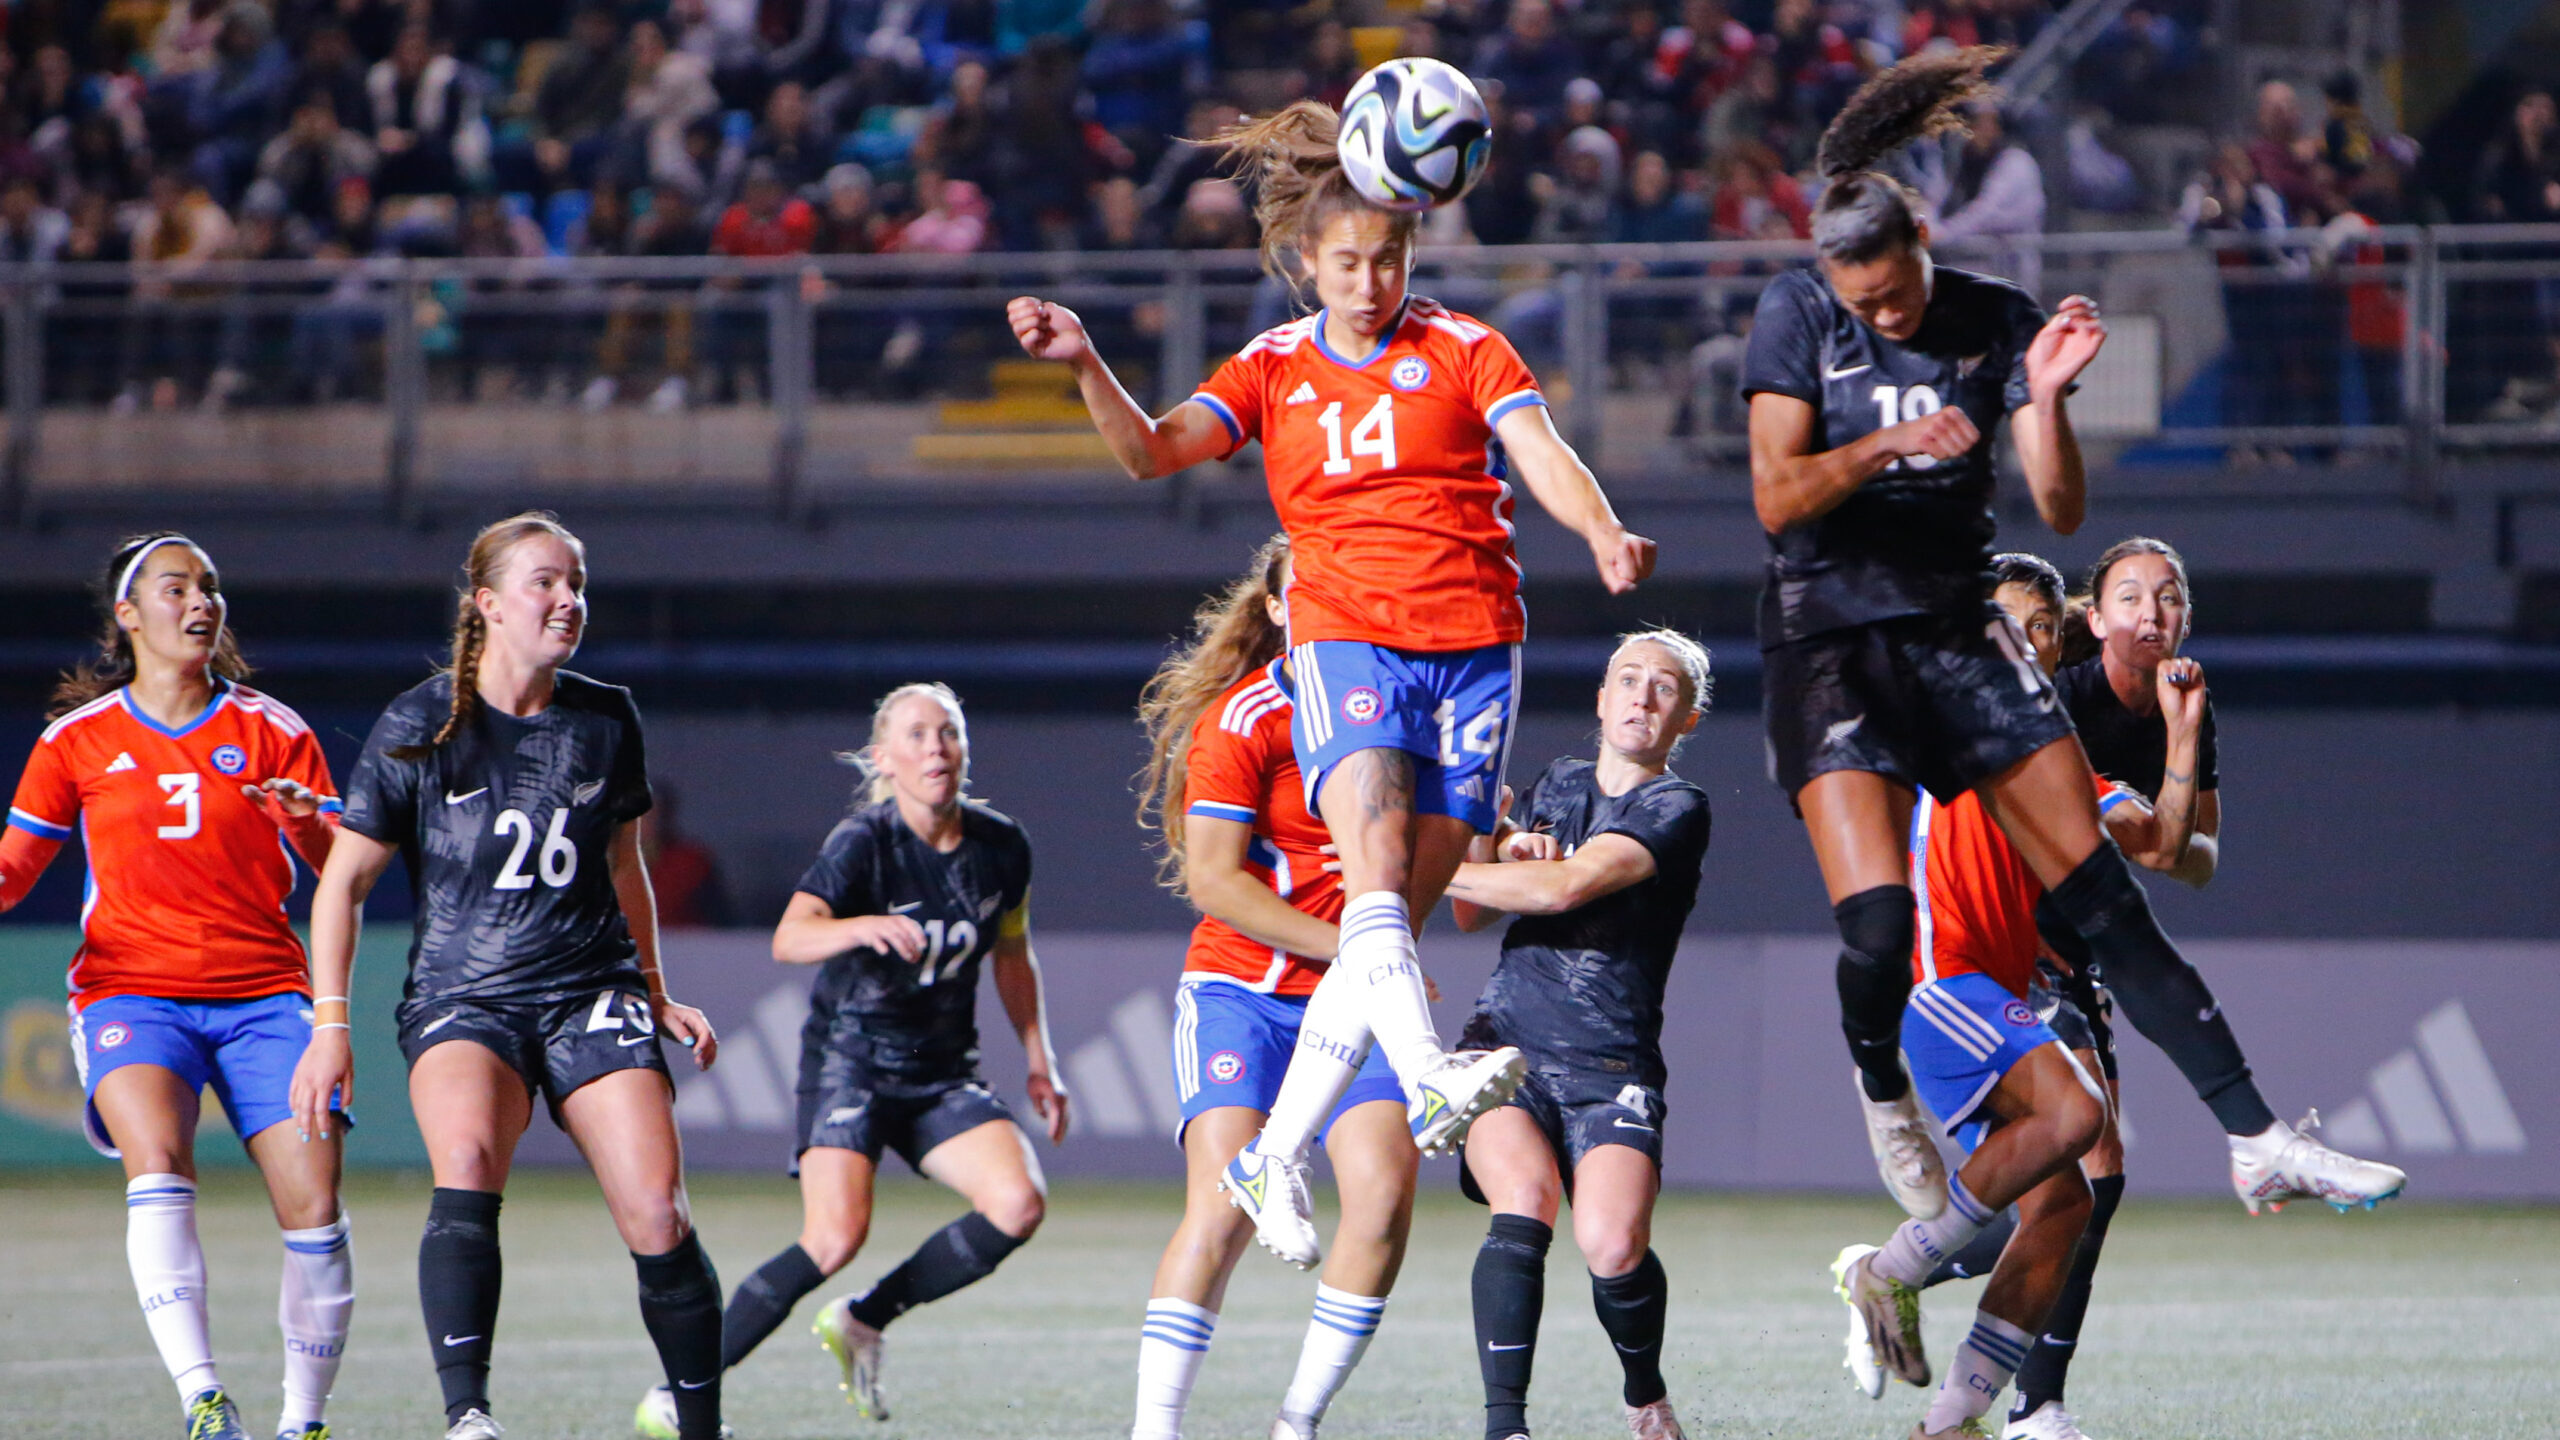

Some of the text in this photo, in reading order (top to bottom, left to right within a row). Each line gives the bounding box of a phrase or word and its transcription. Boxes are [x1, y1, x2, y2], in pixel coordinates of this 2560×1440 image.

[1317, 393, 1397, 476] 14
[1432, 698, 1502, 772] 14
[157, 772, 200, 839] 3
[493, 807, 578, 891] 26
[918, 919, 978, 987] 12
[1616, 1084, 1650, 1119] 4
